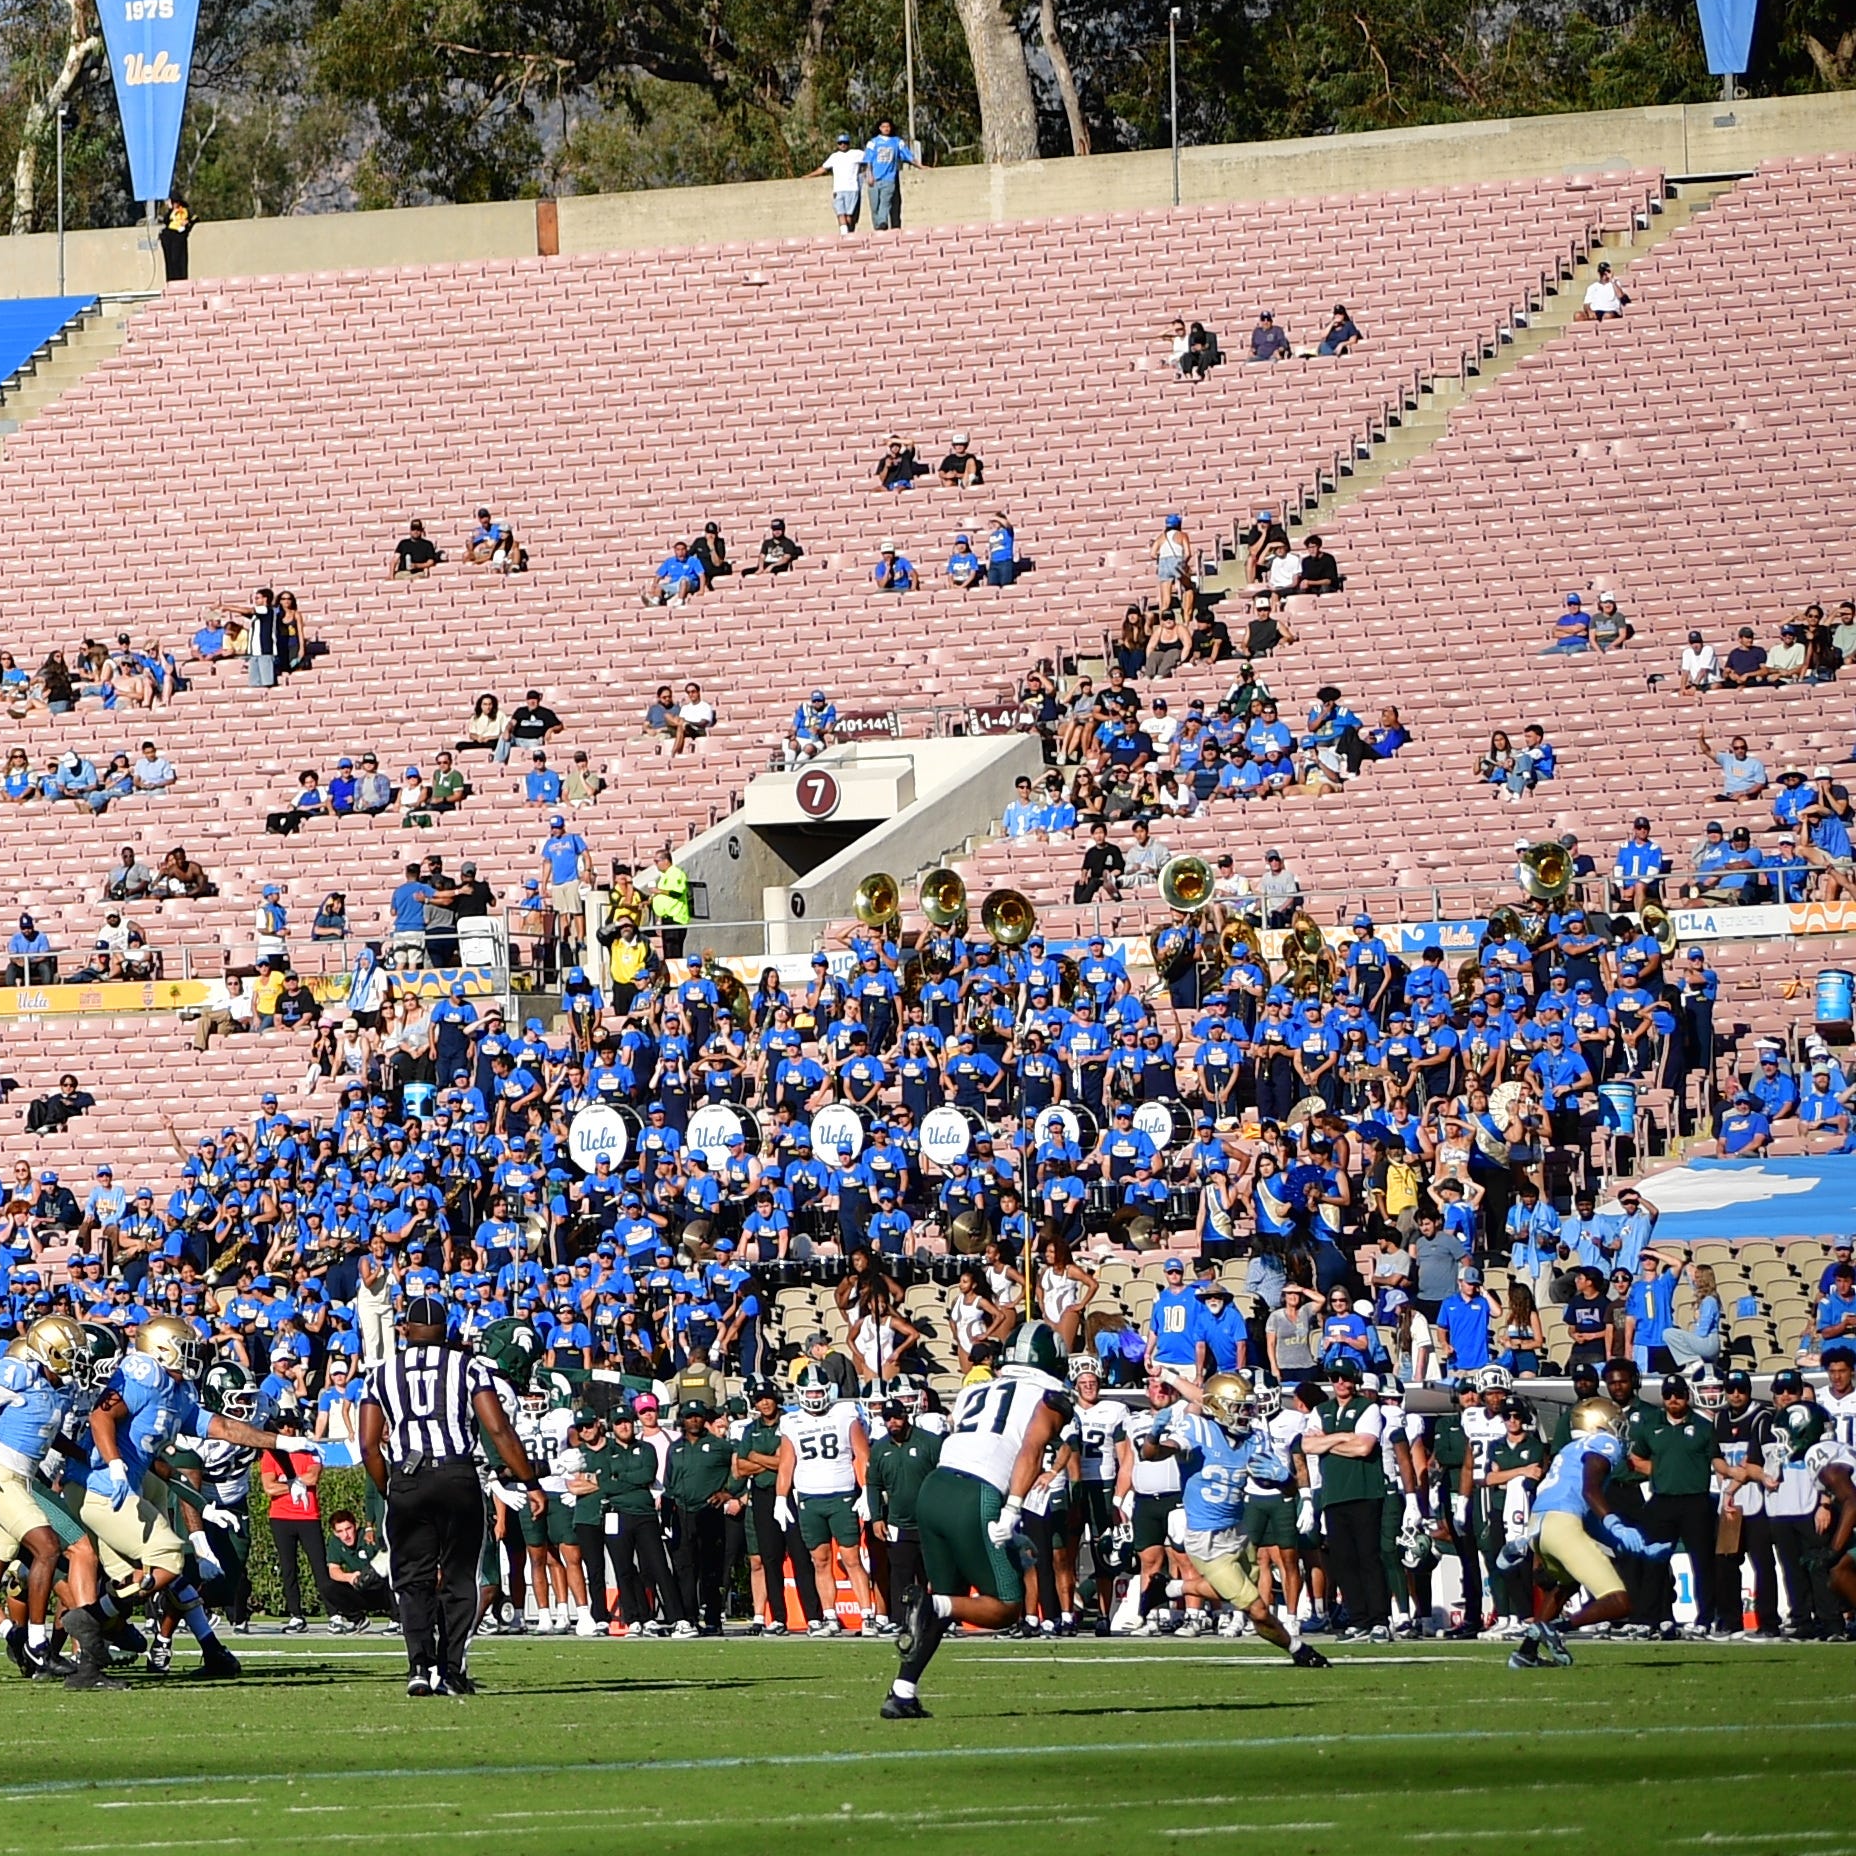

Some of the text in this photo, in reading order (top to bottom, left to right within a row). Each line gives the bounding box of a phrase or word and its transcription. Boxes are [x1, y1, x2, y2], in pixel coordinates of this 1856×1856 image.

[125, 0, 175, 21] 1975
[123, 50, 182, 85] Ucla
[839, 717, 888, 732] 101-141
[807, 778, 827, 806] 7
[1631, 856, 1639, 877] 1
[1439, 925, 1475, 946] Ucla
[18, 992, 48, 1009] Ucla
[578, 1128, 617, 1153] Ucla
[819, 1125, 855, 1145] Ucla
[927, 1126, 960, 1145] Ucla
[1041, 1124, 1072, 1142] Ua
[1646, 1291, 1654, 1319] 1
[1163, 1305, 1186, 1333] 10
[129, 1359, 149, 1380] 58
[406, 1370, 438, 1416] U
[958, 1380, 1017, 1435] 21
[798, 1434, 838, 1460] 58
[1807, 1448, 1829, 1470] 24
[1677, 1572, 1692, 1604] 1
